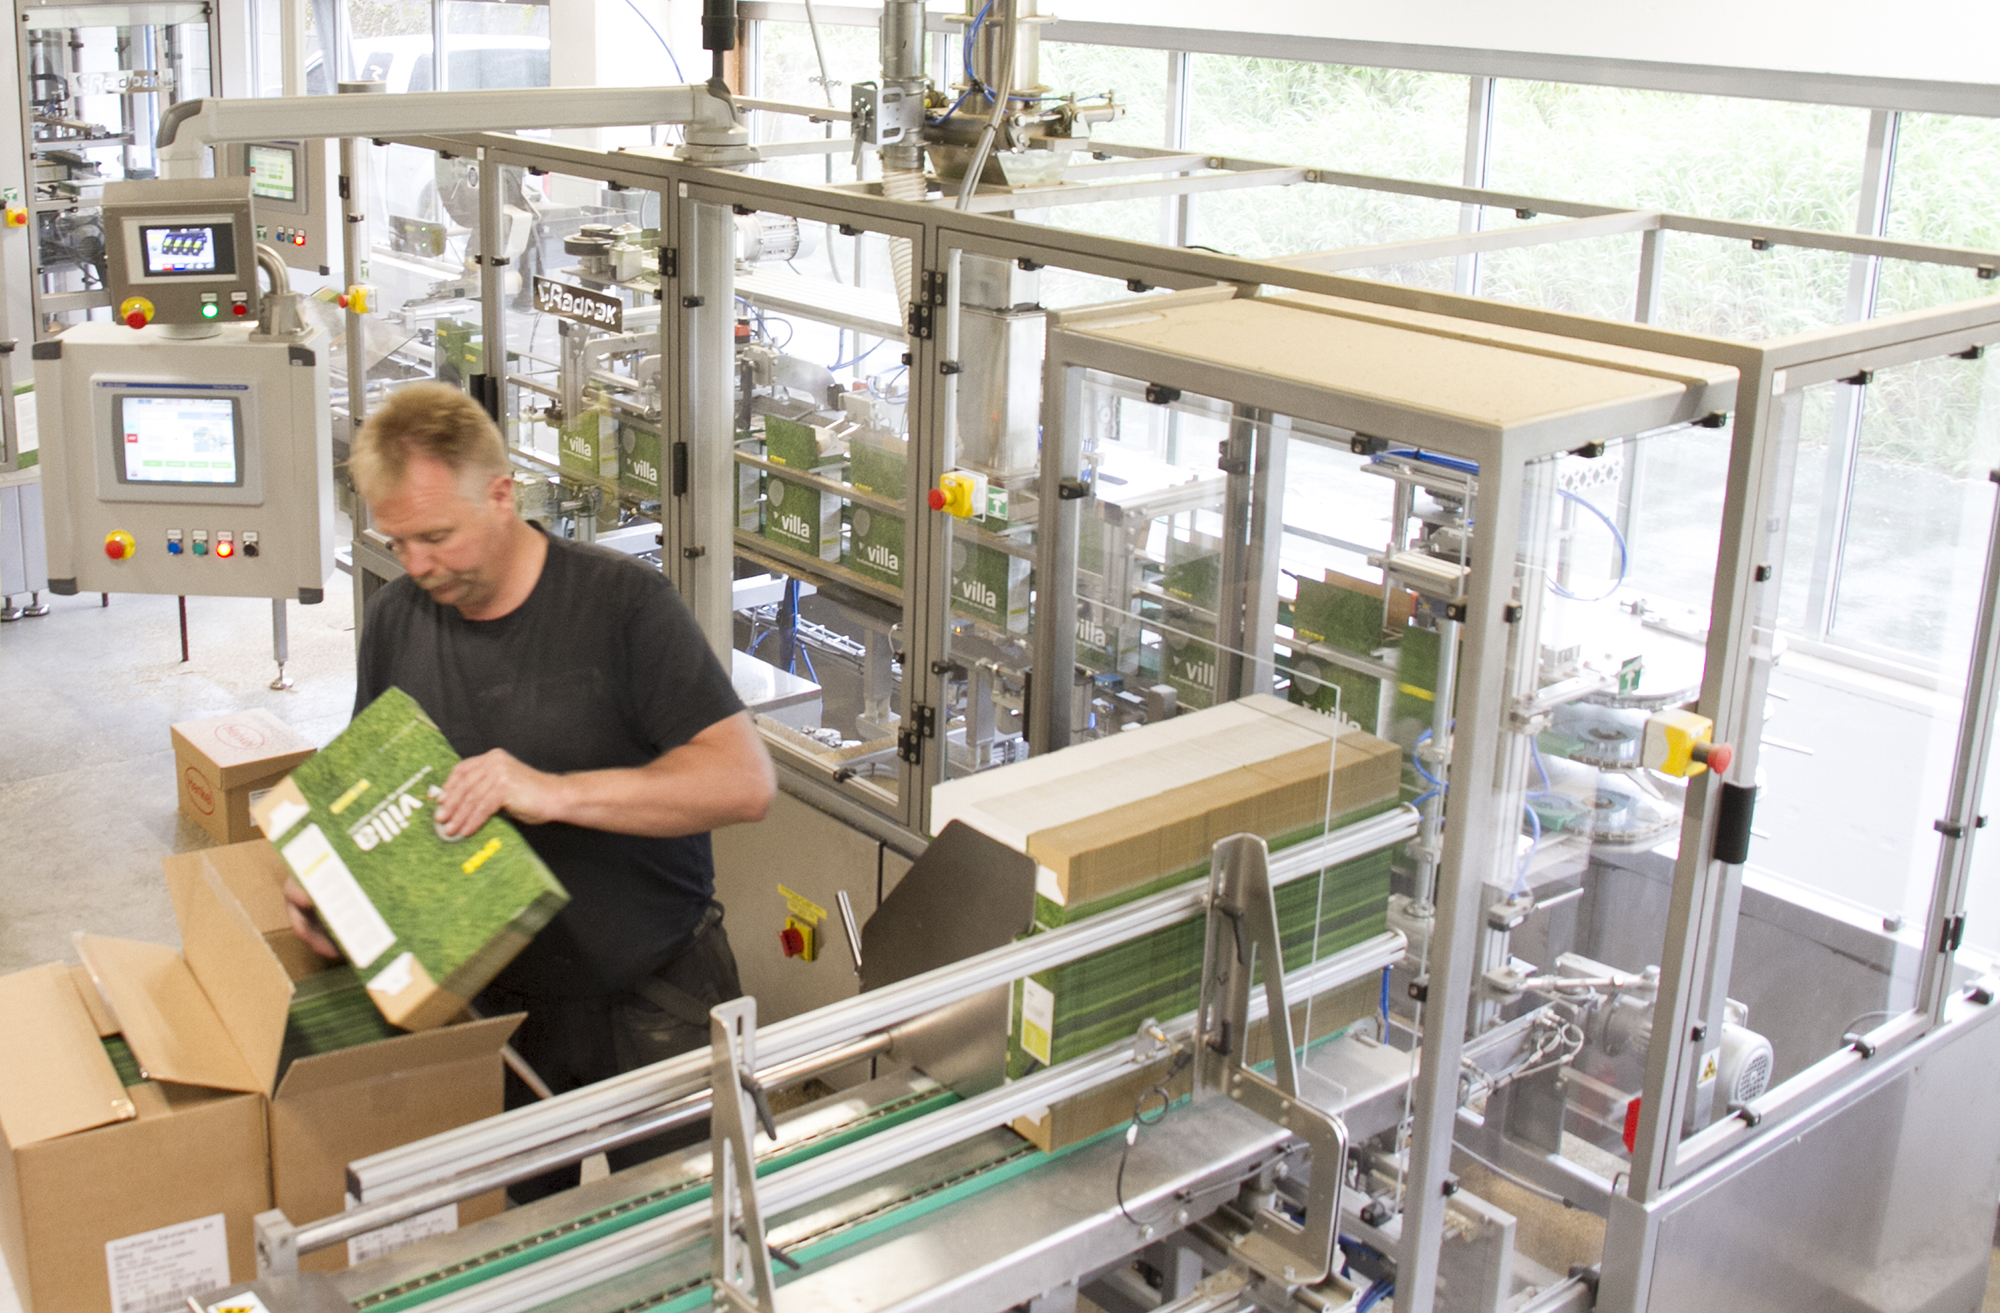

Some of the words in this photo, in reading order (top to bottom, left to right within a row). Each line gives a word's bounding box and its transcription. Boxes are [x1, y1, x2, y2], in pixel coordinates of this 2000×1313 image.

[548, 284, 617, 325] Radpak
[569, 437, 592, 457] villa
[633, 460, 658, 482] villa
[781, 514, 810, 538] villa
[867, 545, 899, 570] villa
[962, 580, 997, 609] villa
[1186, 661, 1214, 687] vill
[352, 793, 424, 851] villa
